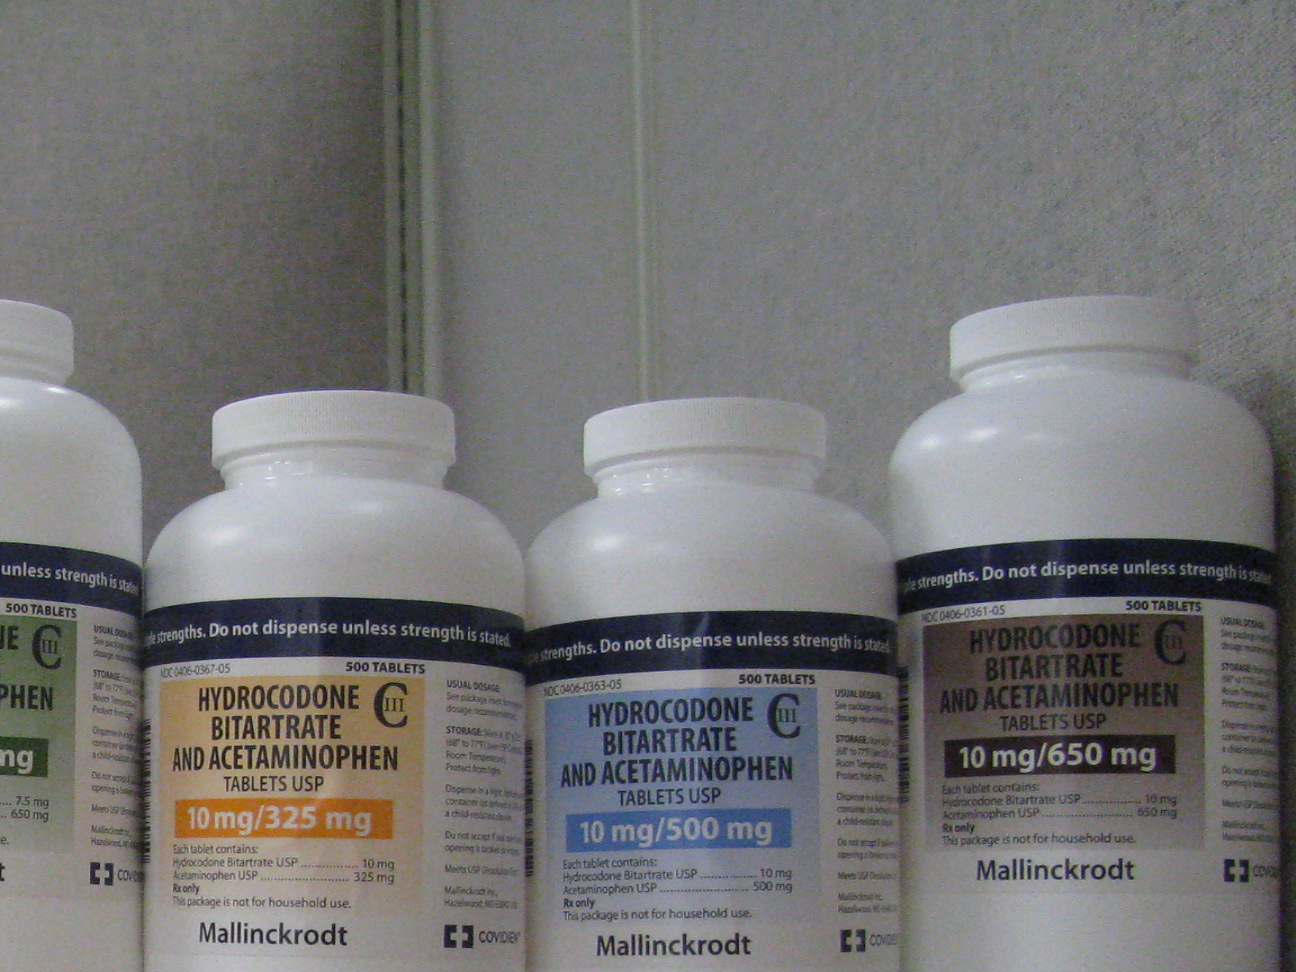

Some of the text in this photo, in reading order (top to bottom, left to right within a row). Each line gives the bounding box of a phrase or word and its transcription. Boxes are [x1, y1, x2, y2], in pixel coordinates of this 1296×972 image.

[2, 564, 51, 578] unless
[55, 568, 107, 588] strength
[918, 571, 979, 590] strengths.
[982, 565, 1004, 581] Do
[1009, 564, 1037, 579] not
[1041, 561, 1118, 578] dispense
[1123, 560, 1175, 575] unless
[1179, 562, 1237, 581] strength
[6, 603, 76, 618] 500 TABLETS
[1126, 600, 1201, 612] 500 TABLETS
[157, 623, 206, 644] strengths.
[209, 622, 228, 636] Do
[232, 622, 258, 635] not
[263, 620, 337, 637] dispense
[343, 622, 396, 636] unless
[401, 624, 464, 641] strength
[468, 628, 476, 640] is
[480, 630, 511, 647] stated.
[970, 625, 1140, 654] HYDROCODONE
[540, 641, 596, 662] strengths.
[600, 638, 622, 653] Do
[625, 637, 651, 651] not
[656, 634, 732, 652] dispense
[736, 632, 788, 647] unless
[793, 634, 851, 650] strength
[346, 661, 425, 674] 500 TABLETS
[739, 673, 815, 685] 500 TABLETS
[986, 654, 1123, 682] BITARTRATE
[198, 684, 359, 712] HYDROCODONE
[940, 683, 1178, 714] AND ACETAMINOPHEN
[588, 697, 753, 728] HYDROCODONE
[1000, 714, 1106, 731] TABLETS USP
[211, 715, 341, 740] BITARTRATE
[603, 727, 736, 756] BITARTRATE
[173, 745, 398, 771] AND ACETAMINOPHEN
[959, 743, 1157, 772] 10 mg/650 mg
[224, 776, 324, 792] TABLETS USP
[561, 757, 792, 788] AND ACETAMINOPHEN
[617, 788, 721, 806] TABLETS USP
[187, 806, 372, 836] 10 mg/325 mg
[579, 817, 772, 845] 10 mg/500 mg
[977, 859, 1134, 881] Mallinckrodt
[564, 908, 752, 922] This package is not for household use.
[199, 922, 348, 946] Mallinckrodt
[596, 933, 751, 956] Mallinckrodt
